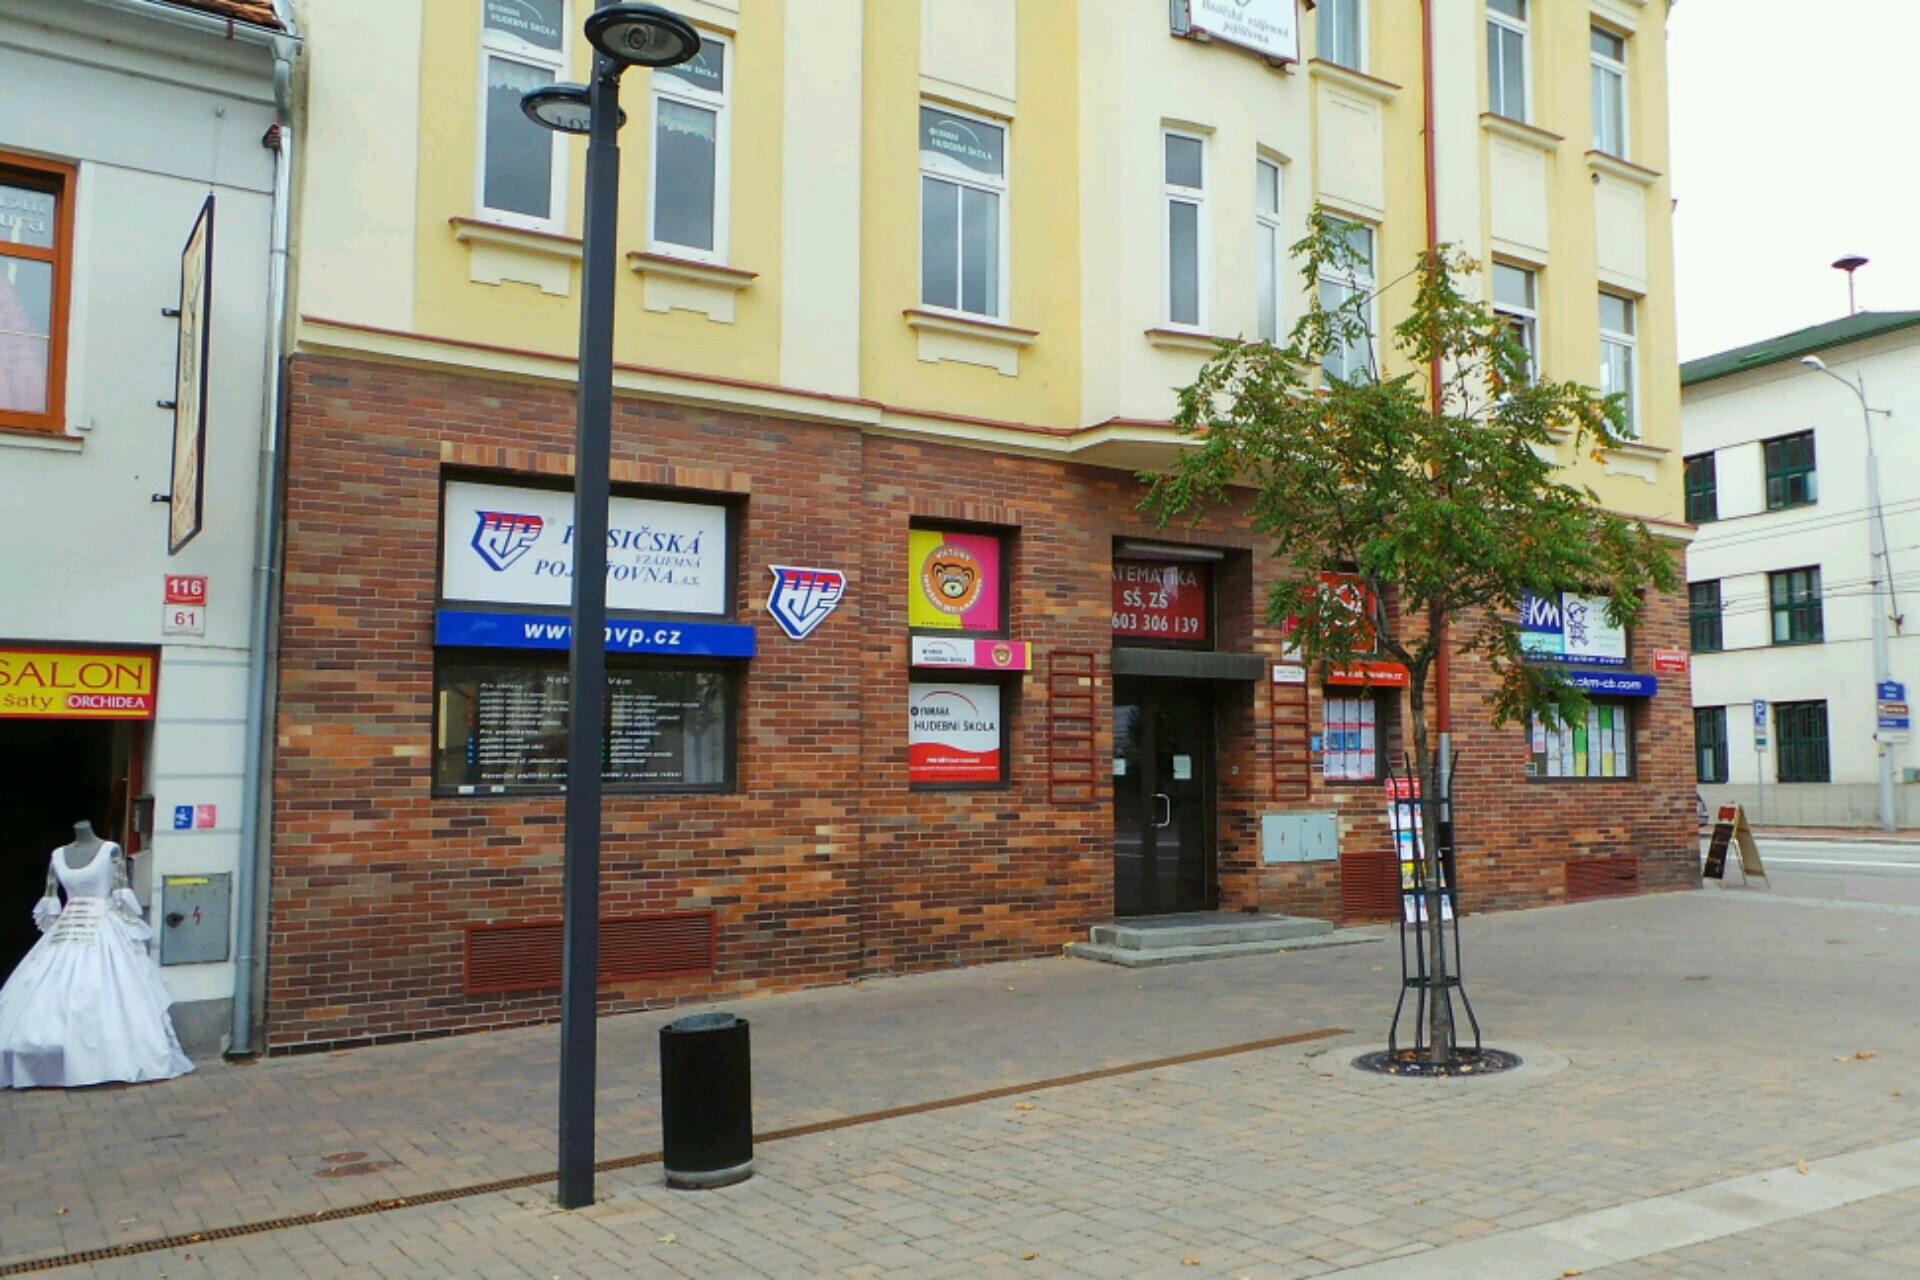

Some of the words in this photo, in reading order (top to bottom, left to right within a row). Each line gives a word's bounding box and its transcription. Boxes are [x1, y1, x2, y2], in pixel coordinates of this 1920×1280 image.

[170, 580, 202, 595] 116
[175, 612, 195, 626] 61
[1112, 612, 1137, 630] 603
[1143, 614, 1168, 632] 306
[1175, 616, 1198, 634] 139
[68, 695, 146, 709] ORCHIDEA
[914, 719, 960, 732] HUDEBNÍ
[963, 718, 996, 732] ŠKOLA
